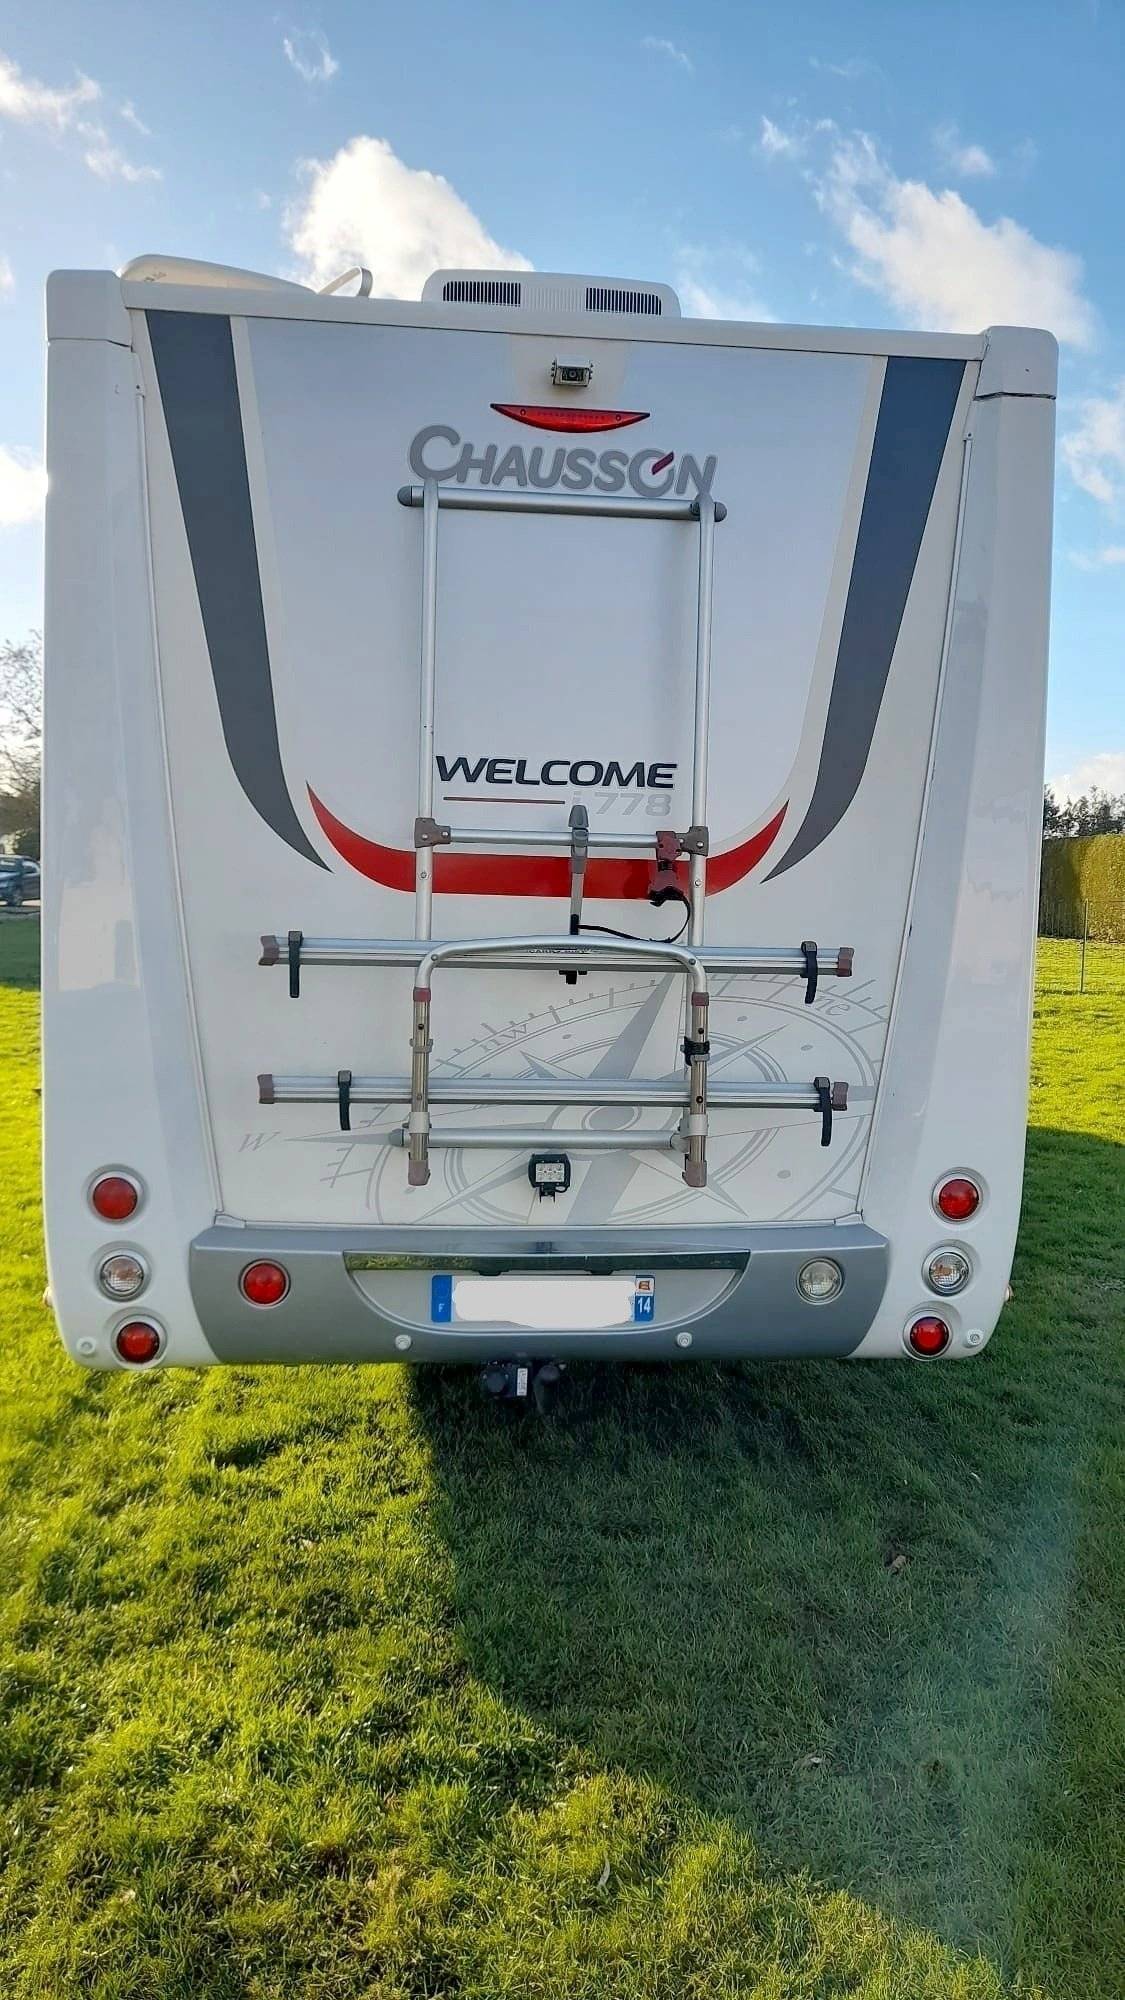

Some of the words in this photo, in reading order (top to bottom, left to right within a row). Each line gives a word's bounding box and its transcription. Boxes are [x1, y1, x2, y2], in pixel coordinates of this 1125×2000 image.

[410, 425, 717, 498] CHAUSSON
[435, 755, 677, 788] WELCOME
[438, 1303, 445, 1312] F
[638, 1297, 651, 1313] 14
